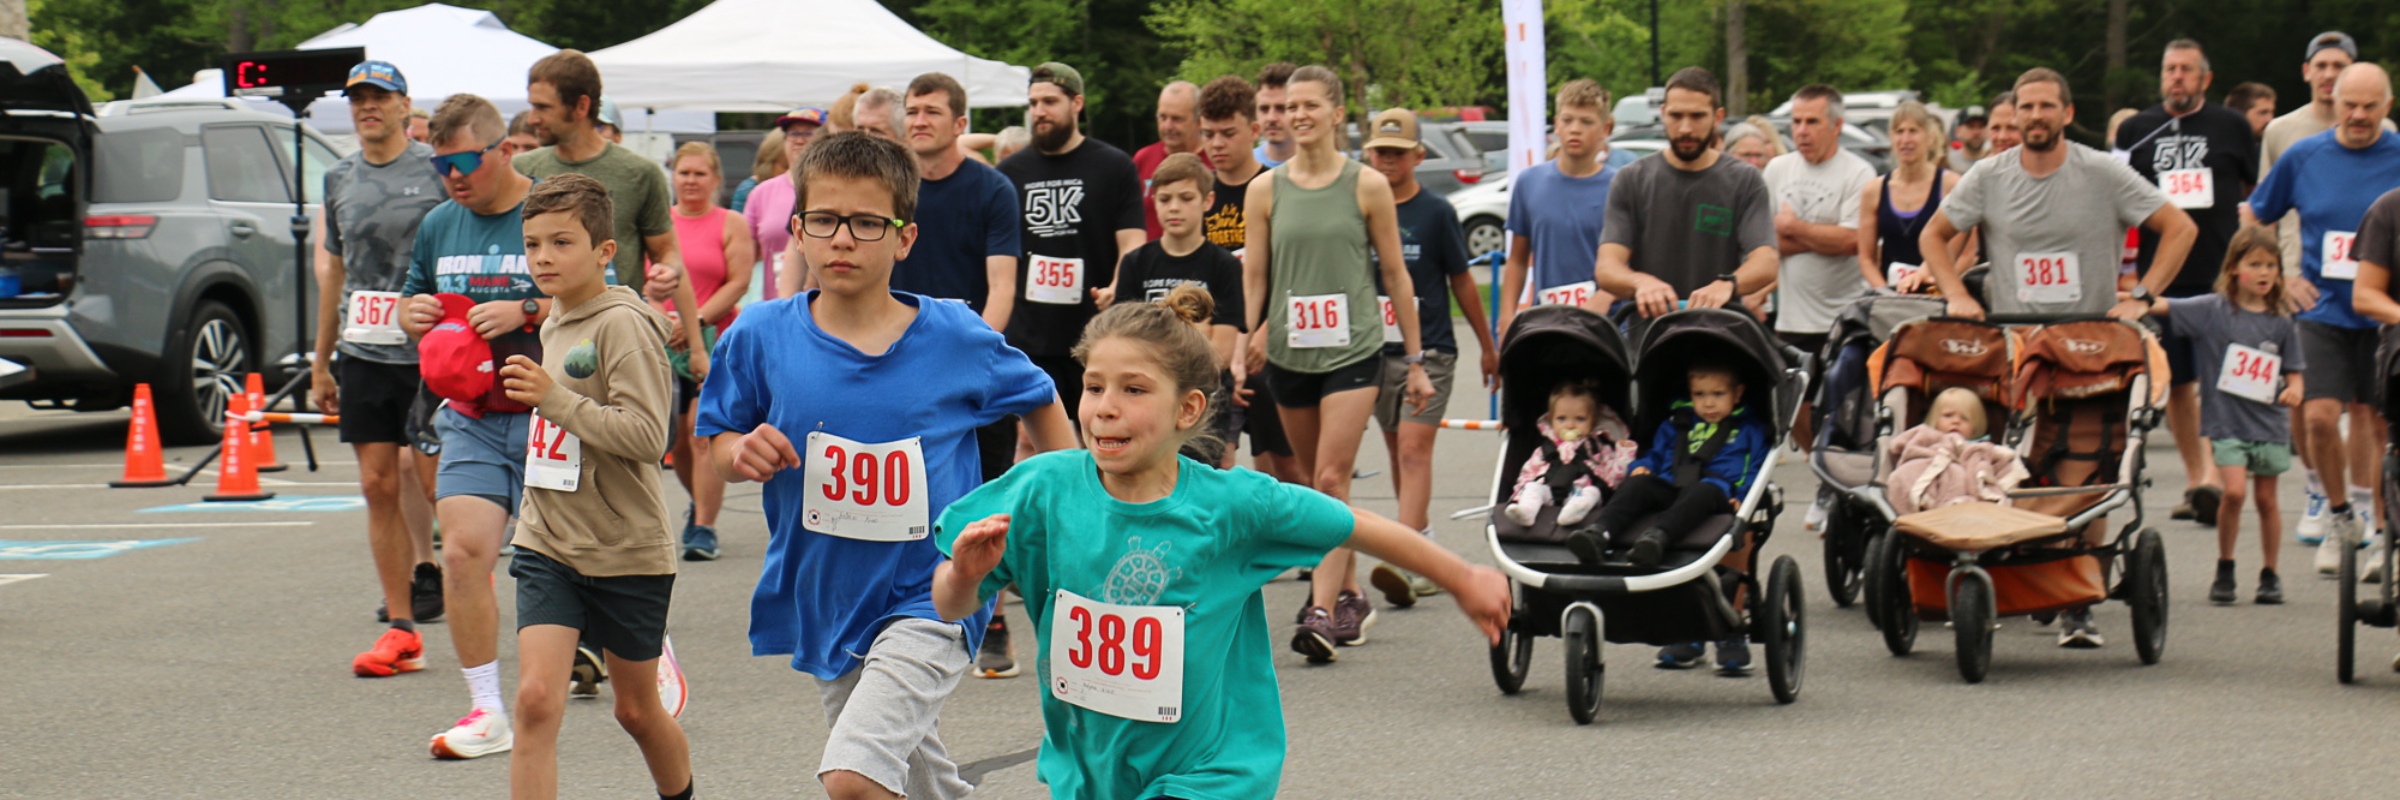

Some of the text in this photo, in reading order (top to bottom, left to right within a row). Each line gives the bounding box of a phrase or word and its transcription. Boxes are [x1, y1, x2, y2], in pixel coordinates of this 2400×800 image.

[2168, 173, 2203, 195] 364
[1025, 186, 1082, 226] 5K
[436, 253, 531, 275] IRONMAN
[1035, 260, 1075, 288] 355
[2023, 257, 2068, 286] 381
[469, 275, 511, 287] MAINE
[356, 296, 397, 325] 367
[1294, 299, 1339, 330] 316
[2232, 351, 2274, 385] 344
[822, 445, 910, 506] 390
[1069, 605, 1162, 680] 389
